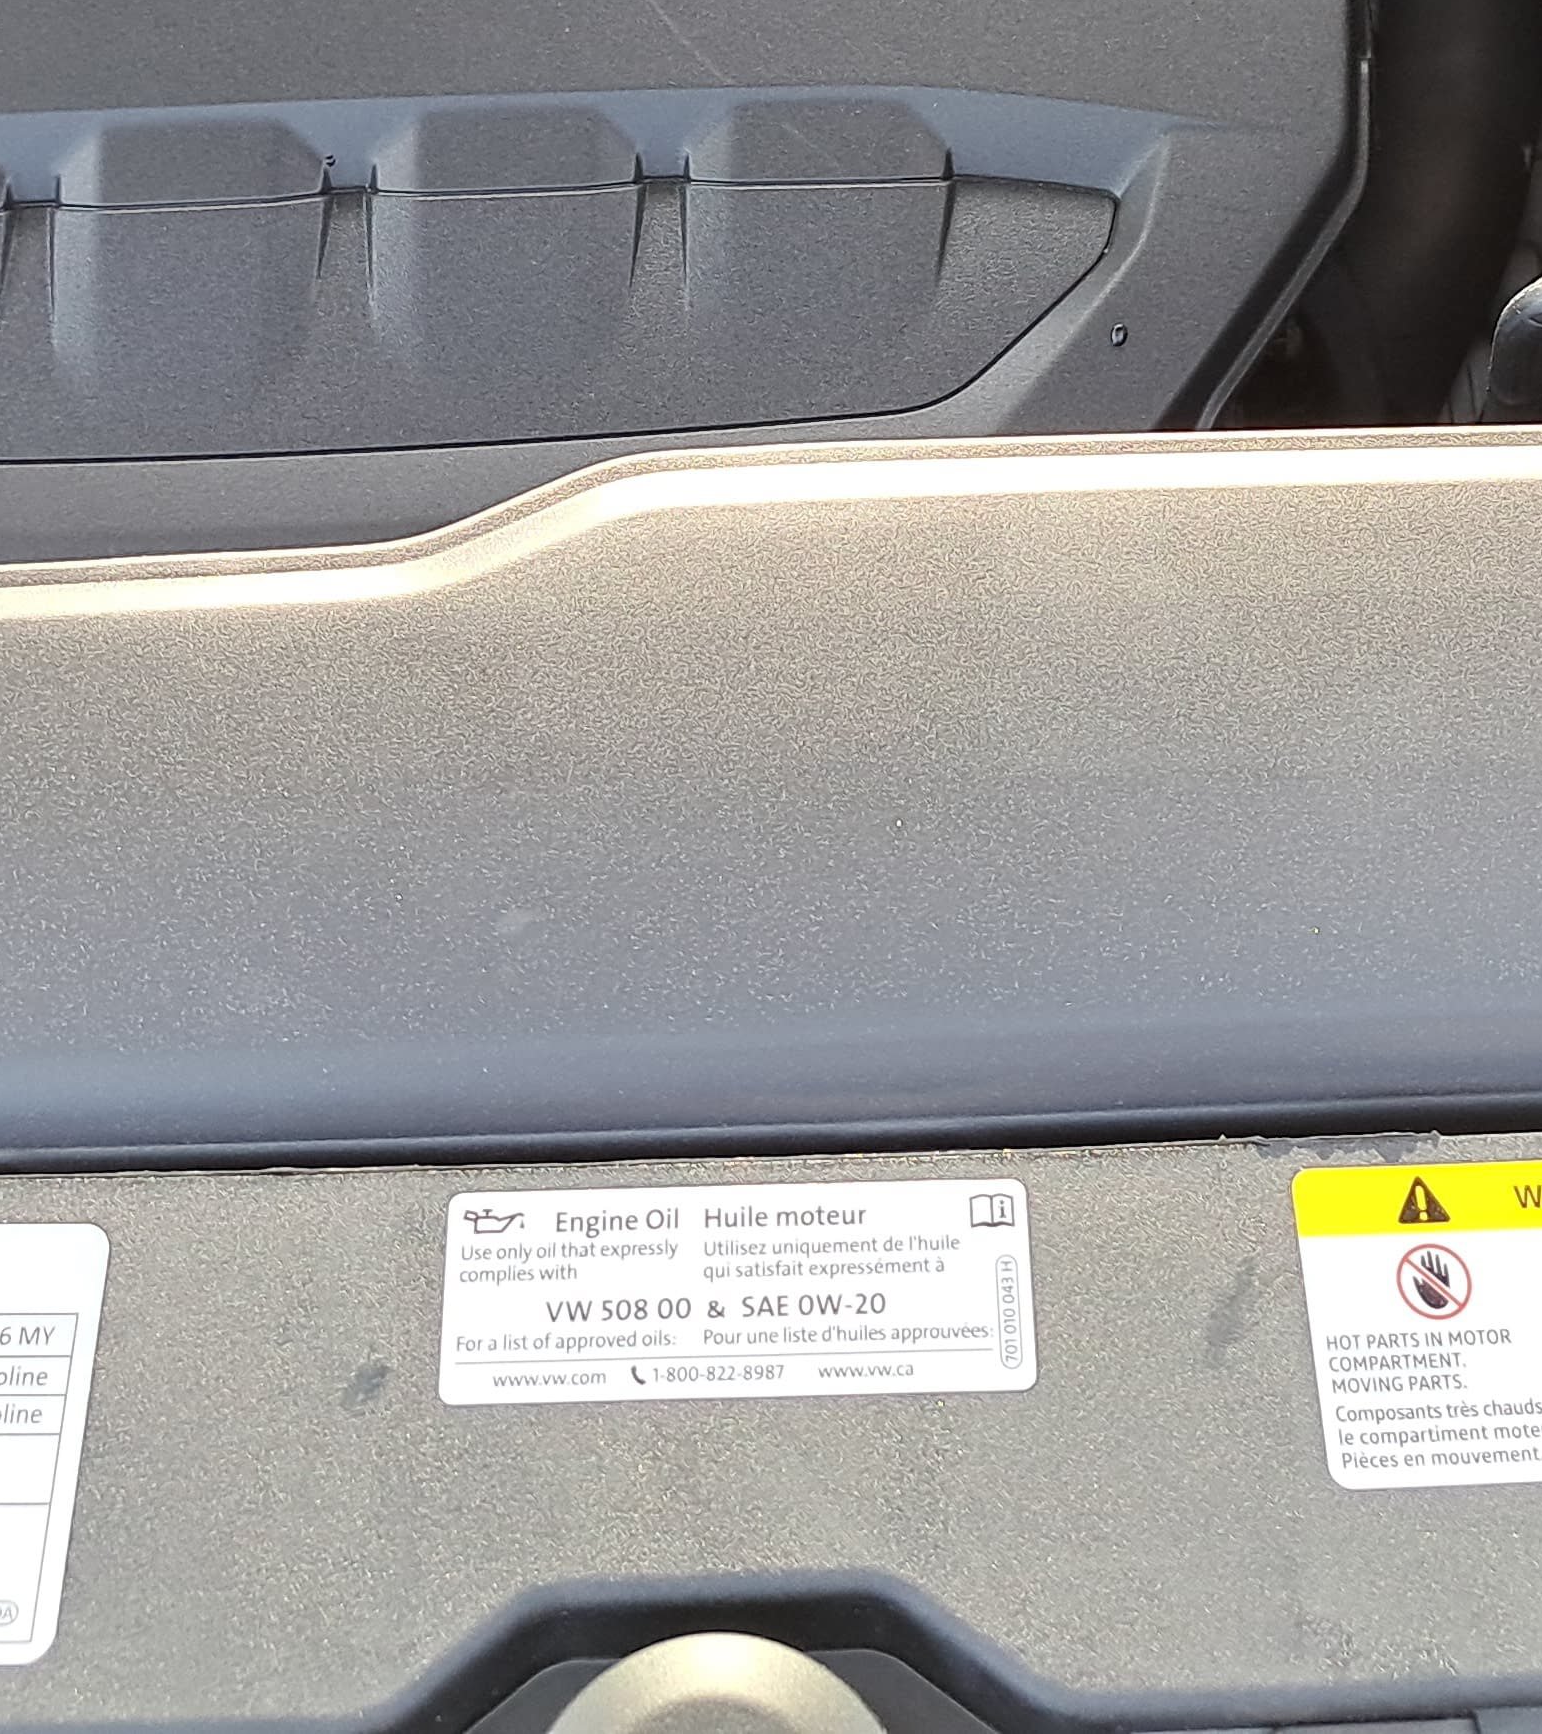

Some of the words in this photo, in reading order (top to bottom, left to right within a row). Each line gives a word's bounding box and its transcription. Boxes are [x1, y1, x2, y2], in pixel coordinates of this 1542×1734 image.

[556, 1210, 639, 1238] Engine
[646, 1208, 679, 1231] Oil
[704, 1206, 768, 1229] Huile
[776, 1207, 866, 1227] moteur
[461, 1244, 492, 1261] Use
[496, 1244, 532, 1264] only
[535, 1243, 553, 1259] oil
[555, 1242, 597, 1258] that
[600, 1240, 678, 1262] expressly
[703, 1238, 766, 1257] Utilisez
[771, 1237, 879, 1259] uniquement
[885, 1235, 905, 1251] de
[908, 1233, 961, 1251] l'huile
[460, 1264, 539, 1285] complies
[542, 1263, 578, 1280] with
[703, 1261, 731, 1281] qui
[736, 1259, 805, 1278] satisfait
[809, 1256, 930, 1279] expressément
[934, 1256, 946, 1273] à
[546, 1300, 591, 1323] VW
[601, 1298, 652, 1321] 508
[657, 1297, 692, 1320] 00
[707, 1299, 726, 1319] &
[742, 1295, 790, 1317] SAE
[799, 1292, 887, 1316] 0W-20
[18, 1327, 55, 1346] MY
[457, 1334, 485, 1352] For
[487, 1339, 498, 1352] a
[502, 1332, 528, 1351] list
[532, 1331, 551, 1349] of
[555, 1329, 637, 1353] approved
[641, 1328, 677, 1347] oils:
[703, 1328, 737, 1345] Pour
[742, 1330, 776, 1344] une
[781, 1325, 822, 1343] liste
[827, 1323, 887, 1342] d'huiles
[891, 1321, 994, 1345] approuvées:
[1326, 1334, 1360, 1351] HOT
[1367, 1332, 1420, 1349] PARTS
[1425, 1331, 1443, 1347] IN
[1449, 1328, 1512, 1346] MOTOR
[1328, 1352, 1467, 1373] COMPARTMENT.
[492, 1370, 607, 1387] www.vw.com
[652, 1363, 785, 1383] 1-800-822-8987
[817, 1362, 915, 1378] www.vw.ca
[1332, 1376, 1404, 1394] MOVING
[1408, 1373, 1468, 1391] PARTS.
[1335, 1404, 1442, 1424] Composants
[1446, 1401, 1479, 1419] très
[1338, 1428, 1355, 1446] le
[1359, 1425, 1489, 1447] compartiment
[1341, 1451, 1399, 1469] Pièces
[1403, 1452, 1425, 1466] en
